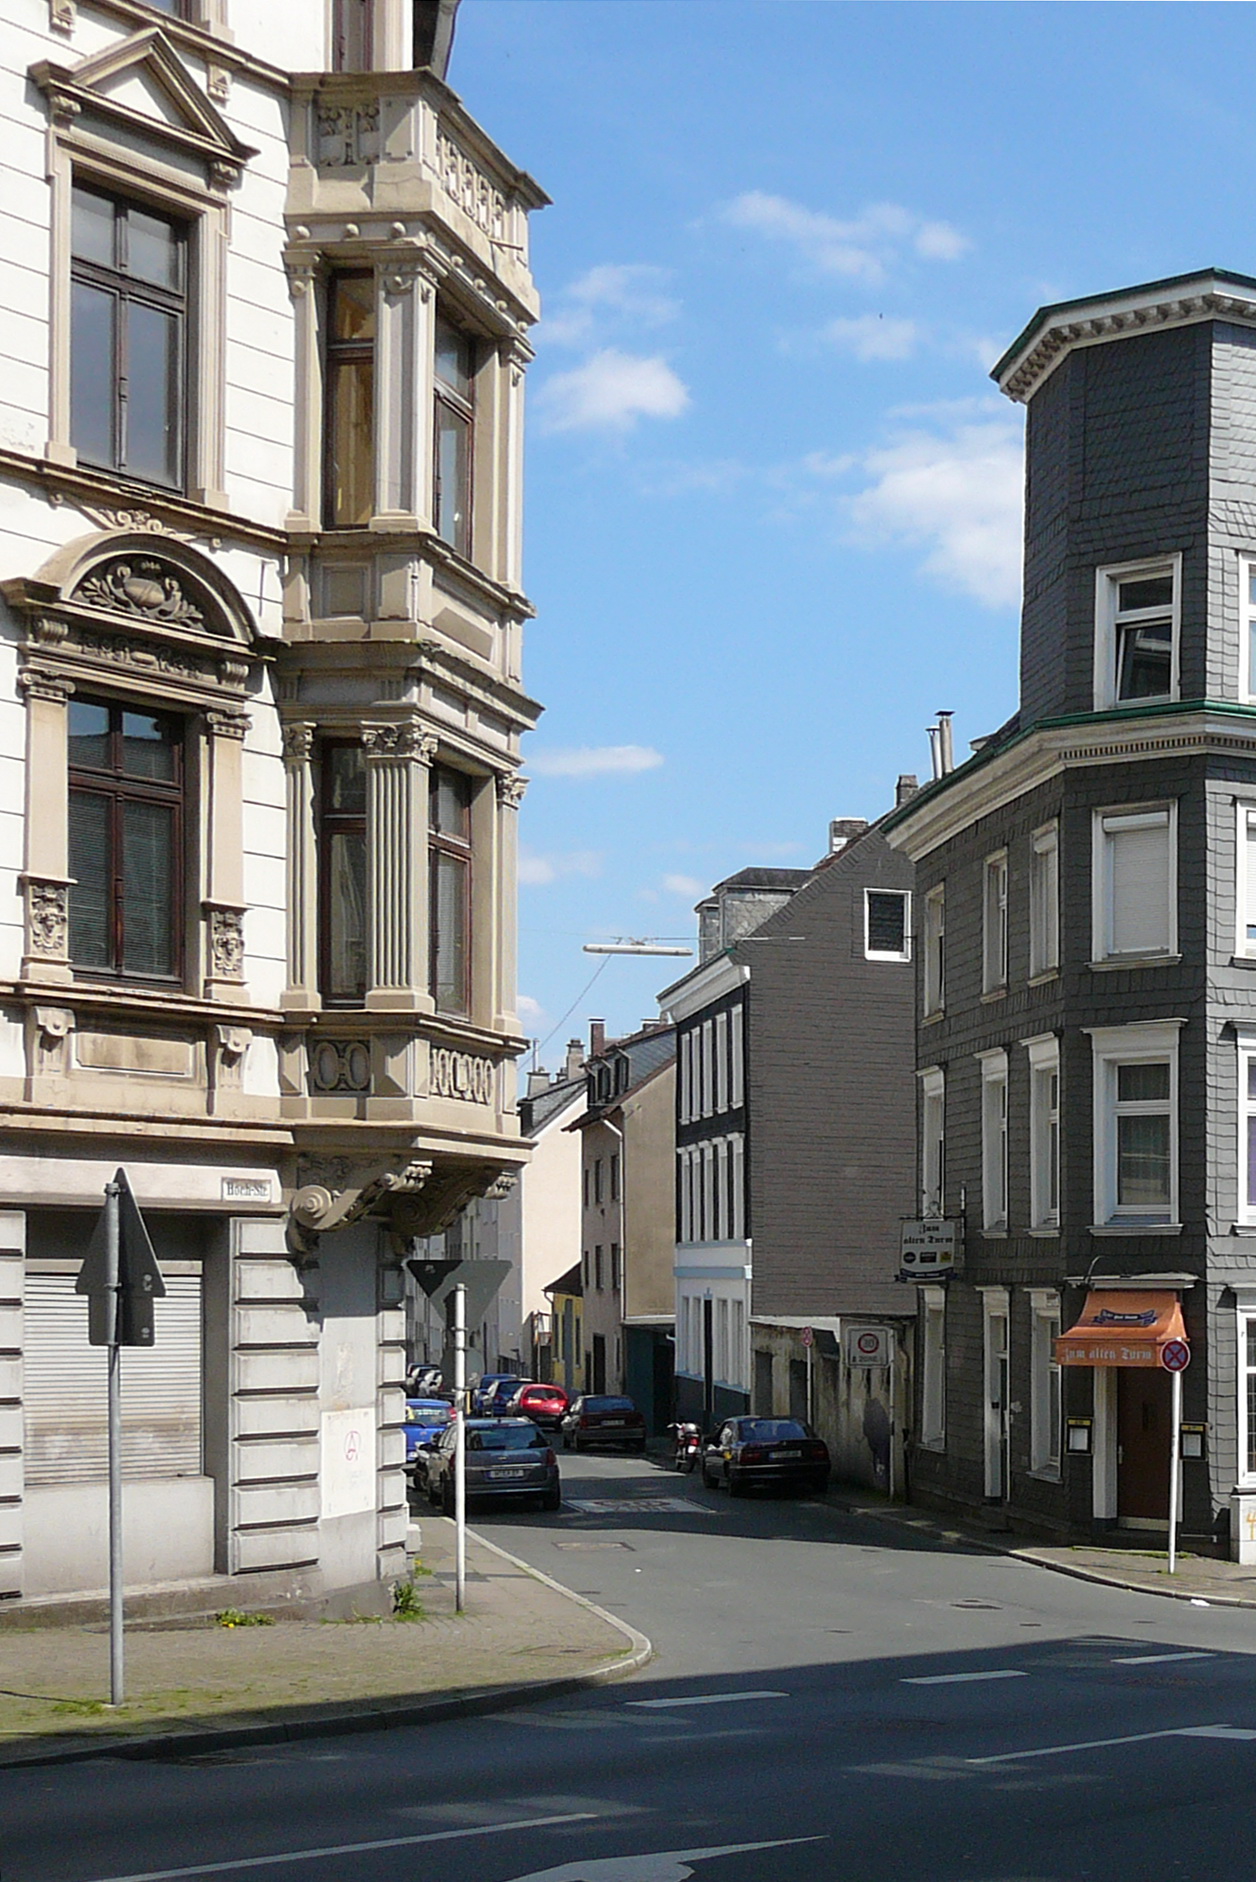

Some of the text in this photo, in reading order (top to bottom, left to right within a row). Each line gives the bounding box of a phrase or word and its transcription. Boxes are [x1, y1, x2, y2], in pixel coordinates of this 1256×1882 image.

[927, 1235, 953, 1244] Turm
[1061, 1346, 1152, 1362] Zum alten Turm
